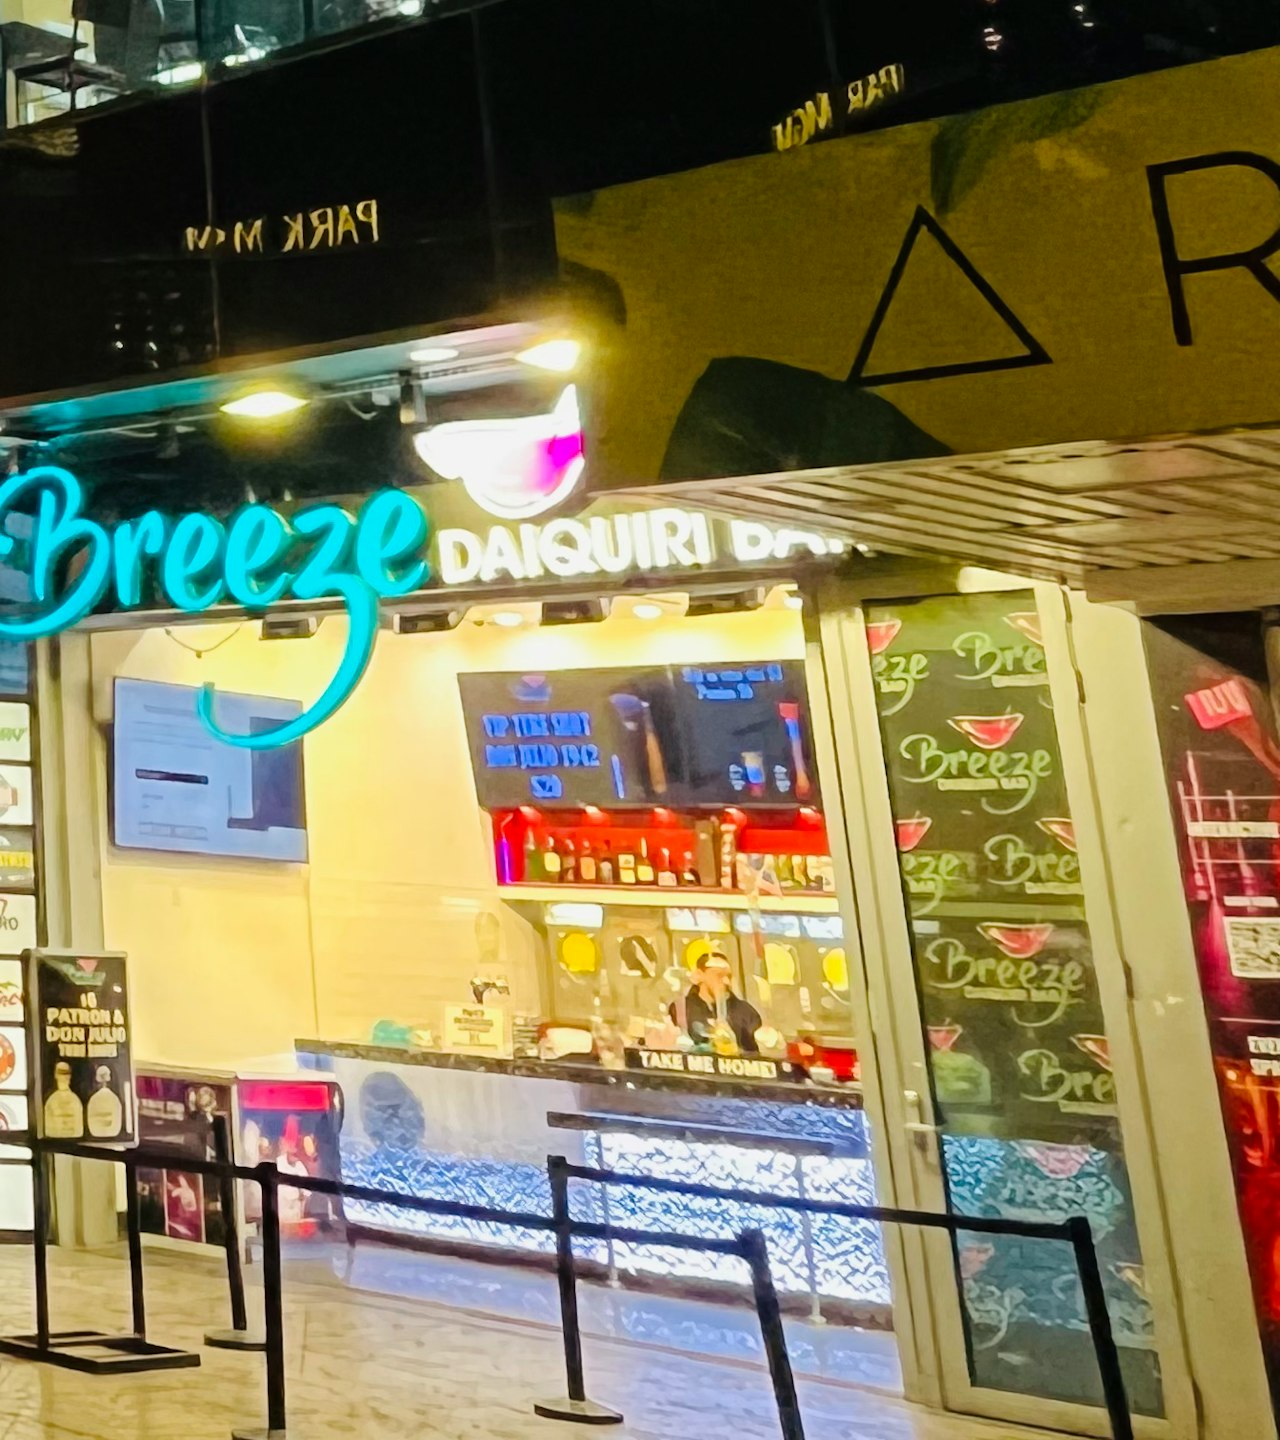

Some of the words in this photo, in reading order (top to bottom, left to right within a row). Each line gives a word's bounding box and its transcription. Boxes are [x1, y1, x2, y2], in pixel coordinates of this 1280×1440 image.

[438, 507, 713, 584] DAIQUIRI
[730, 518, 868, 561] BA
[898, 733, 1054, 815] Breeze
[924, 937, 1086, 1028] Breeze
[45, 1026, 86, 1043] DON
[46, 1007, 111, 1026] PATRON
[640, 1050, 684, 1071] TAKE
[687, 1055, 715, 1073] ME
